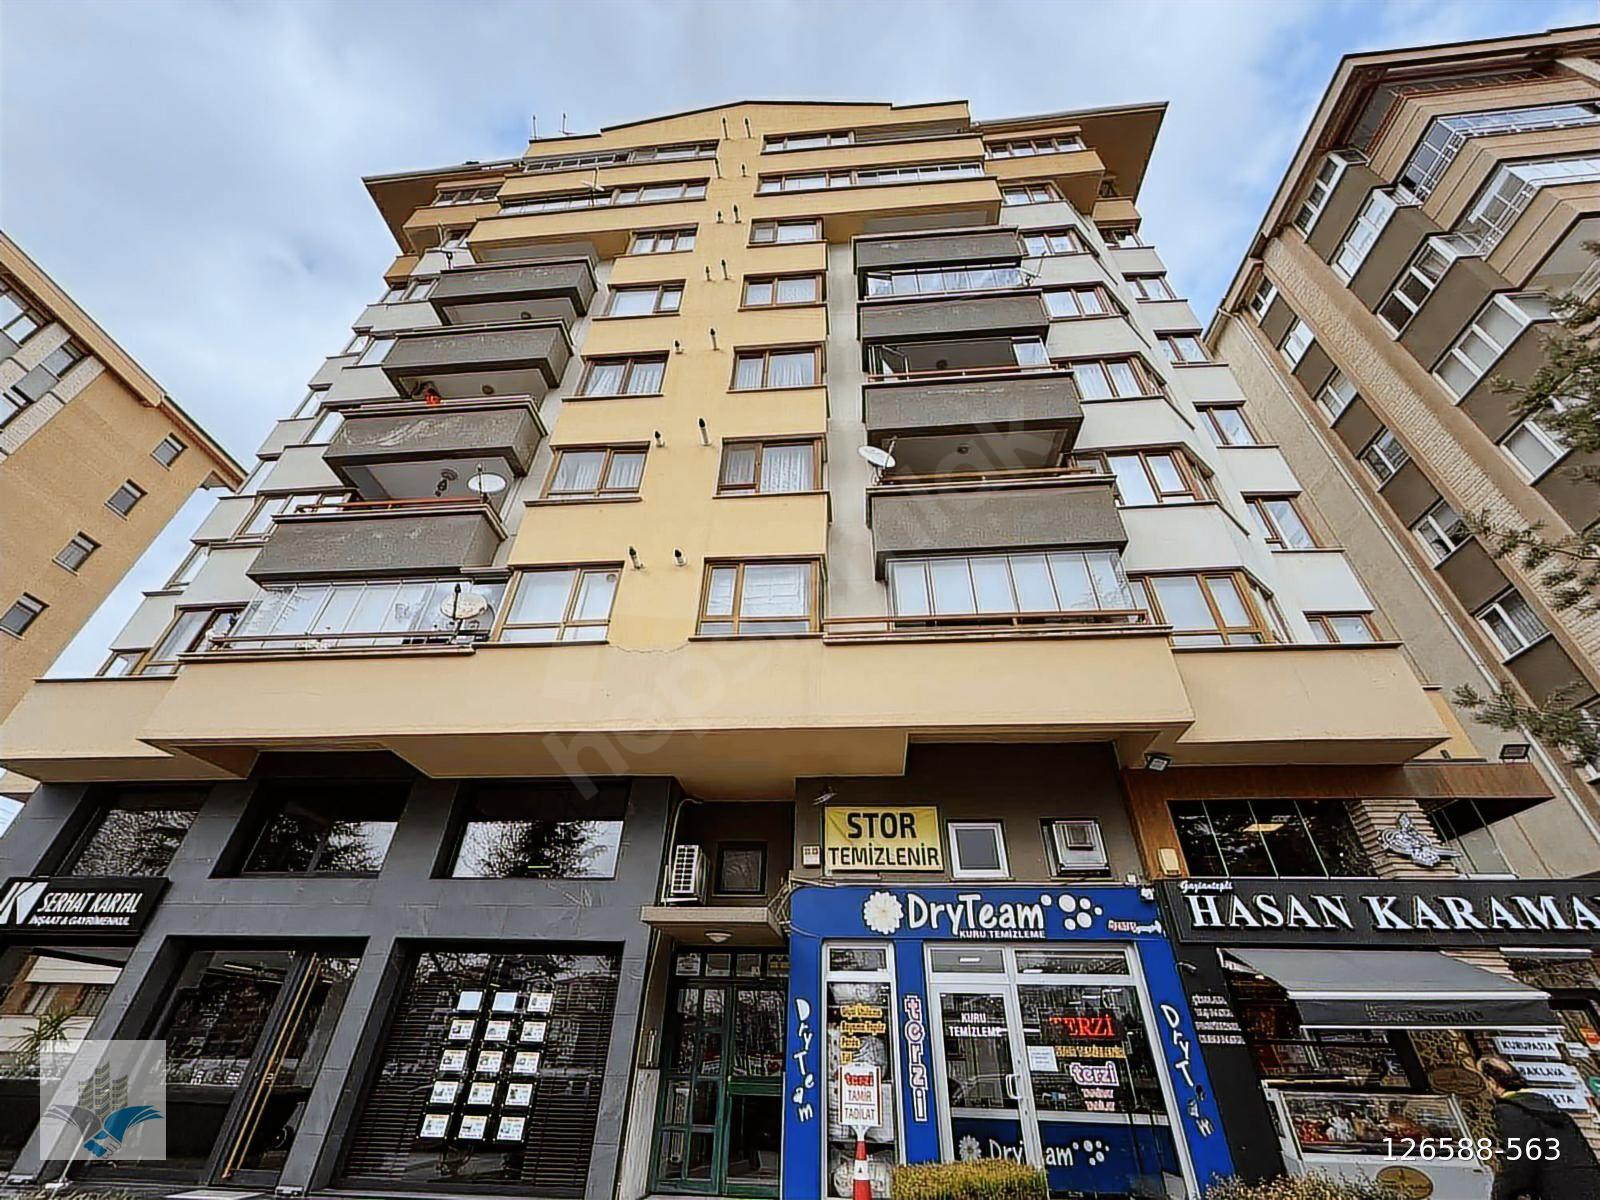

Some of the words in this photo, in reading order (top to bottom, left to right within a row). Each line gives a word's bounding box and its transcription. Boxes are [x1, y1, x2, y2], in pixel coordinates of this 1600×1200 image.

[847, 812, 917, 838] STOR
[828, 843, 940, 866] TEMİZLENİR
[1180, 880, 1233, 893] Gaziantepli
[37, 892, 95, 912] SERHAT
[88, 892, 142, 913] KARTAL
[1185, 894, 1354, 929] HASAN
[1362, 896, 1600, 930] KARAMA
[907, 893, 1044, 936] DryTeam
[959, 930, 986, 939] KURU
[988, 930, 1046, 939] TEMİZLEME
[961, 1012, 987, 1024] KURU
[1048, 1013, 1116, 1037] TERZİ
[949, 1024, 1003, 1037] TEMİZLEME
[1501, 1040, 1556, 1051] KURUPASTA
[792, 998, 816, 1123] DryTeam
[1069, 1060, 1120, 1087] terzi
[847, 1087, 872, 1102] TAMİR
[844, 1107, 875, 1120] TADİLAT
